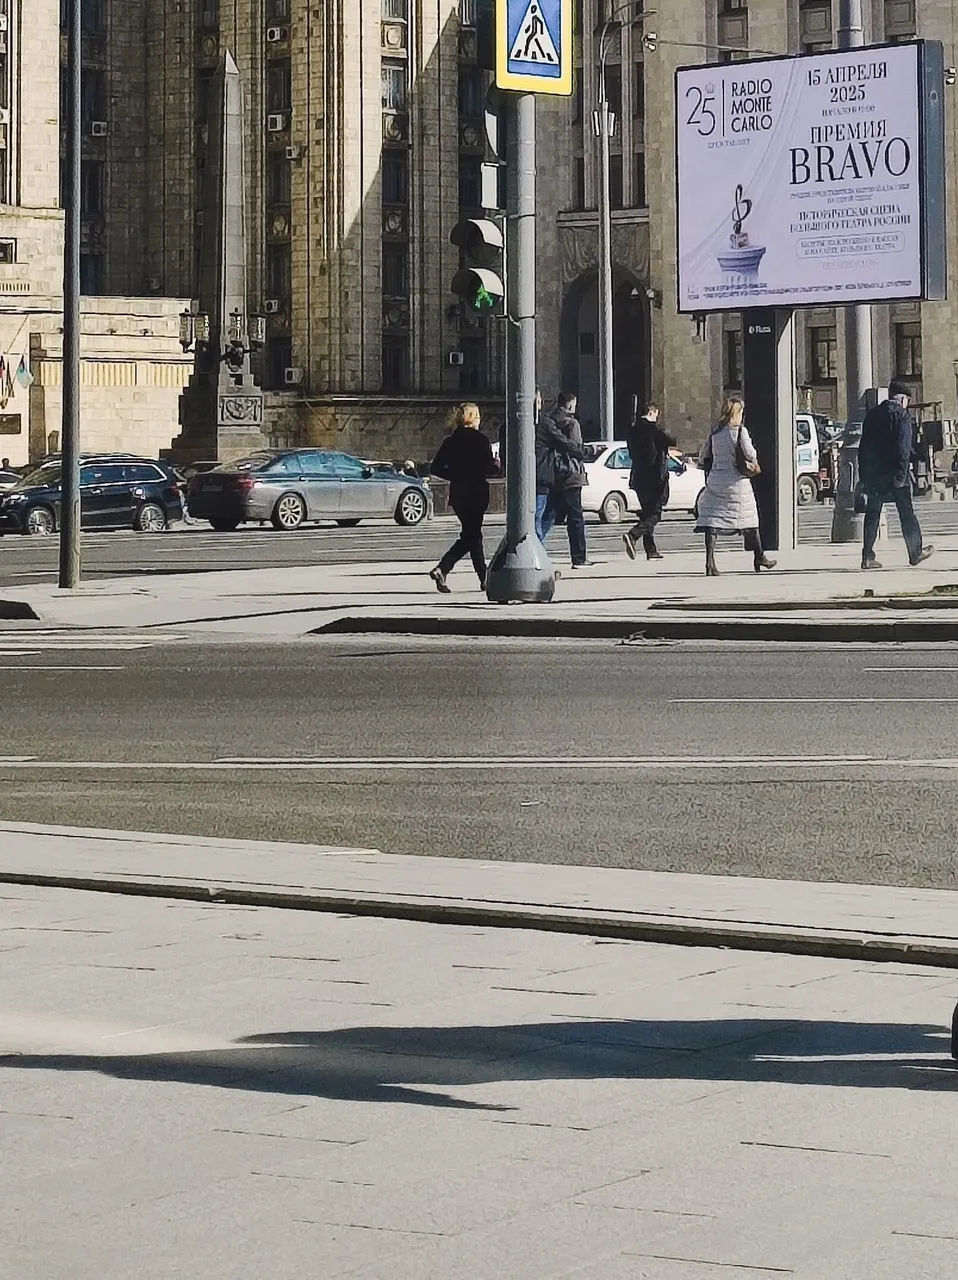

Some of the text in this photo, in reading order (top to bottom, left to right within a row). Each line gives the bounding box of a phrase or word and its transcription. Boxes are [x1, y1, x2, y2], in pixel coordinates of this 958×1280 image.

[808, 61, 888, 86] 15 АПРЕЛЯ
[731, 78, 773, 97] RADIO
[830, 84, 866, 103] 2025
[686, 86, 716, 136] 25
[731, 95, 773, 115] MONTE
[731, 114, 773, 133] CARLO
[811, 119, 887, 144] ПРЕМИЯ
[789, 137, 911, 185] BRAVO
